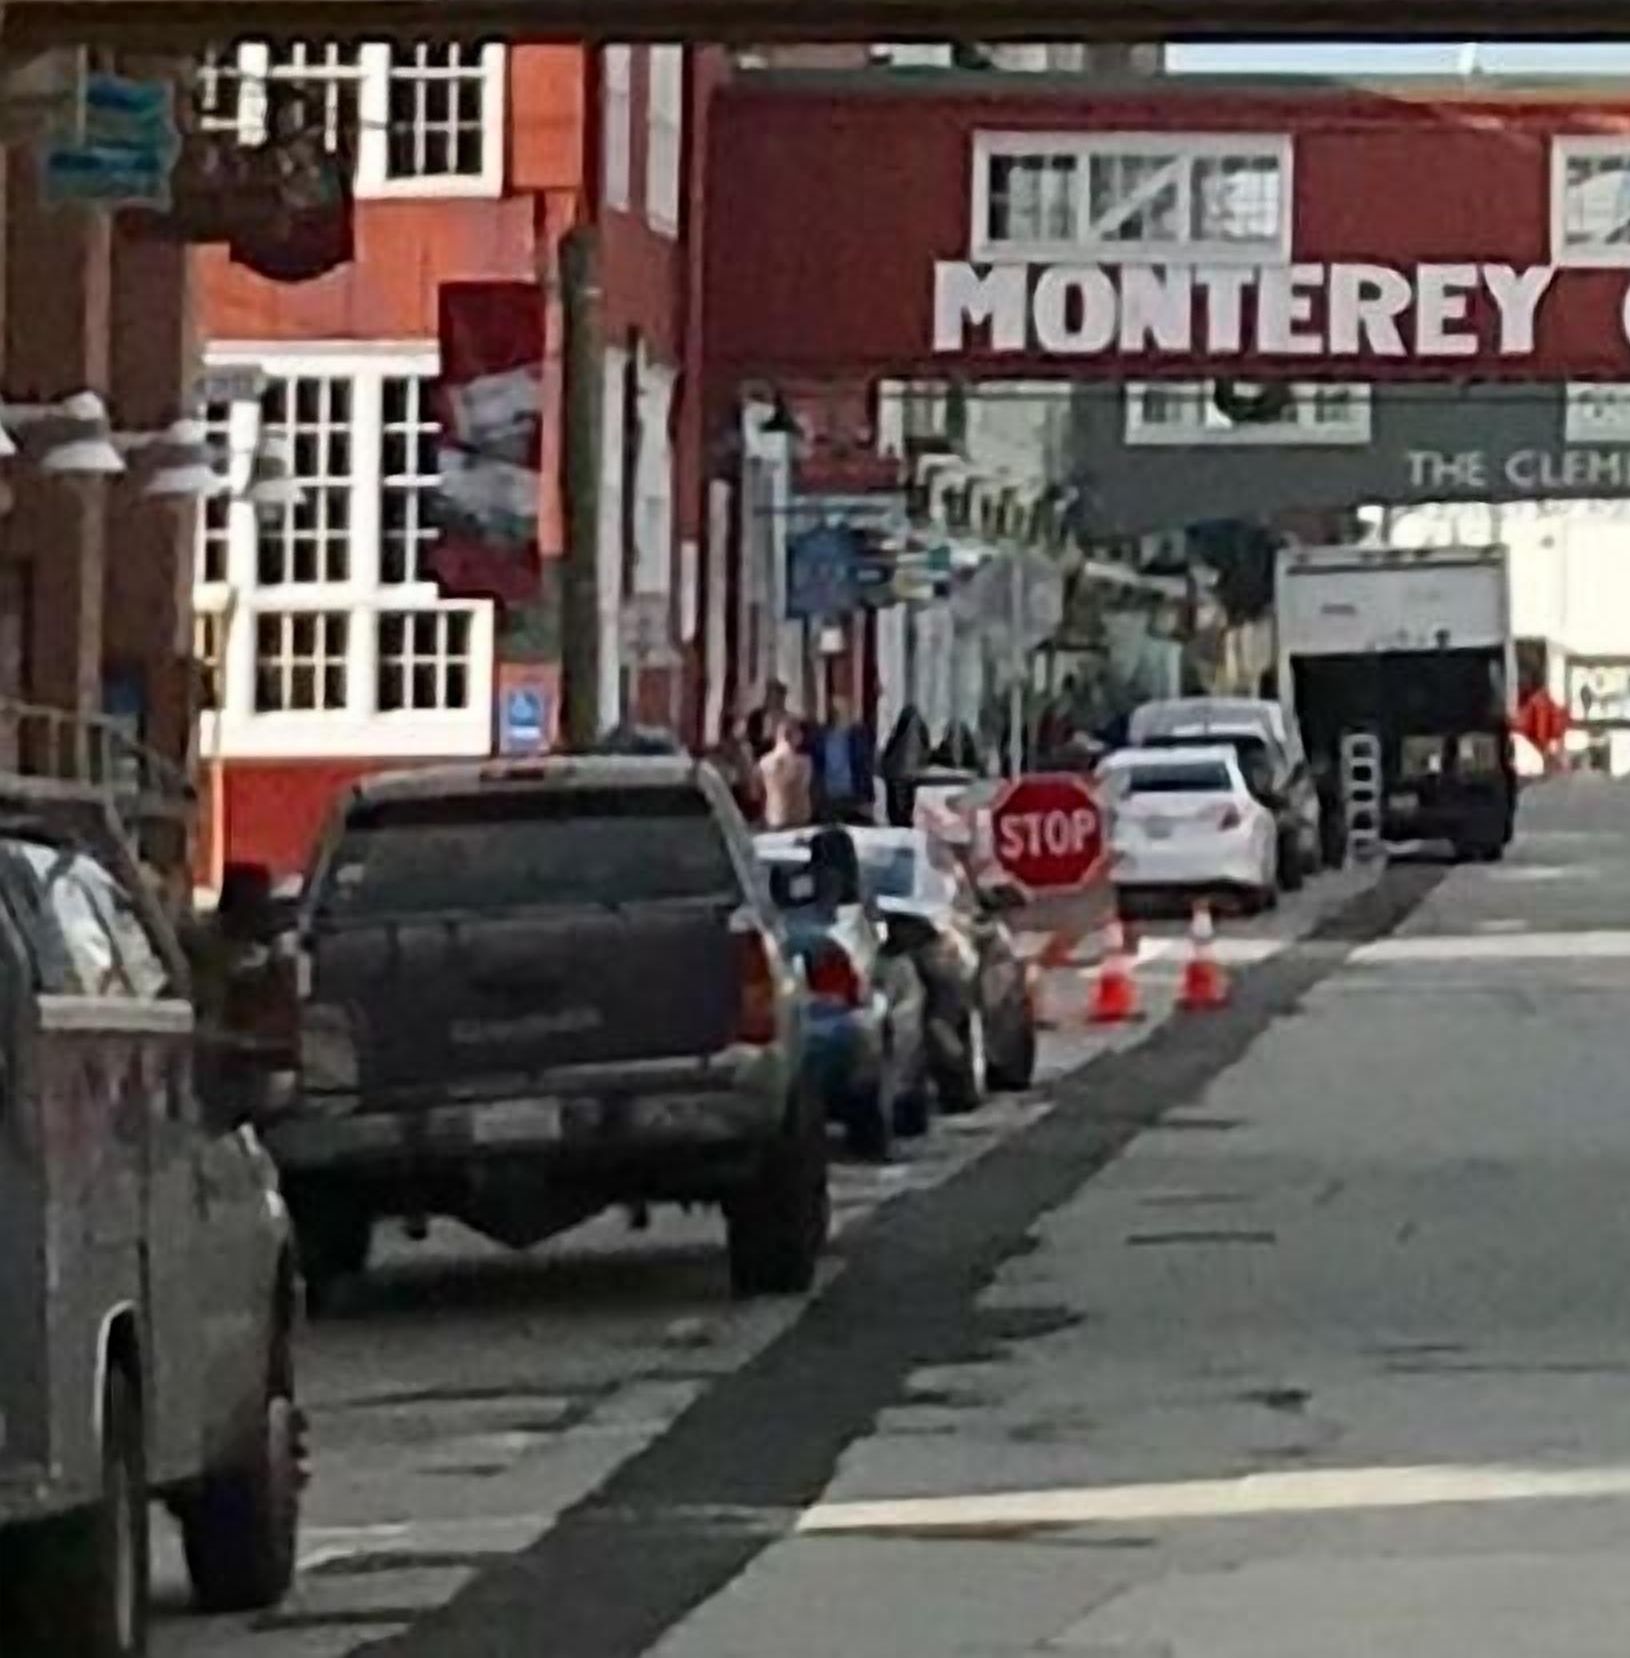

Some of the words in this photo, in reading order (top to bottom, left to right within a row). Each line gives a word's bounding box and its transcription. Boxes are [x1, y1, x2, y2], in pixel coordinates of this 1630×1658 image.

[934, 261, 1555, 356] MONTEREY
[1406, 450, 1486, 487] THE
[1000, 807, 1097, 859] STOP
